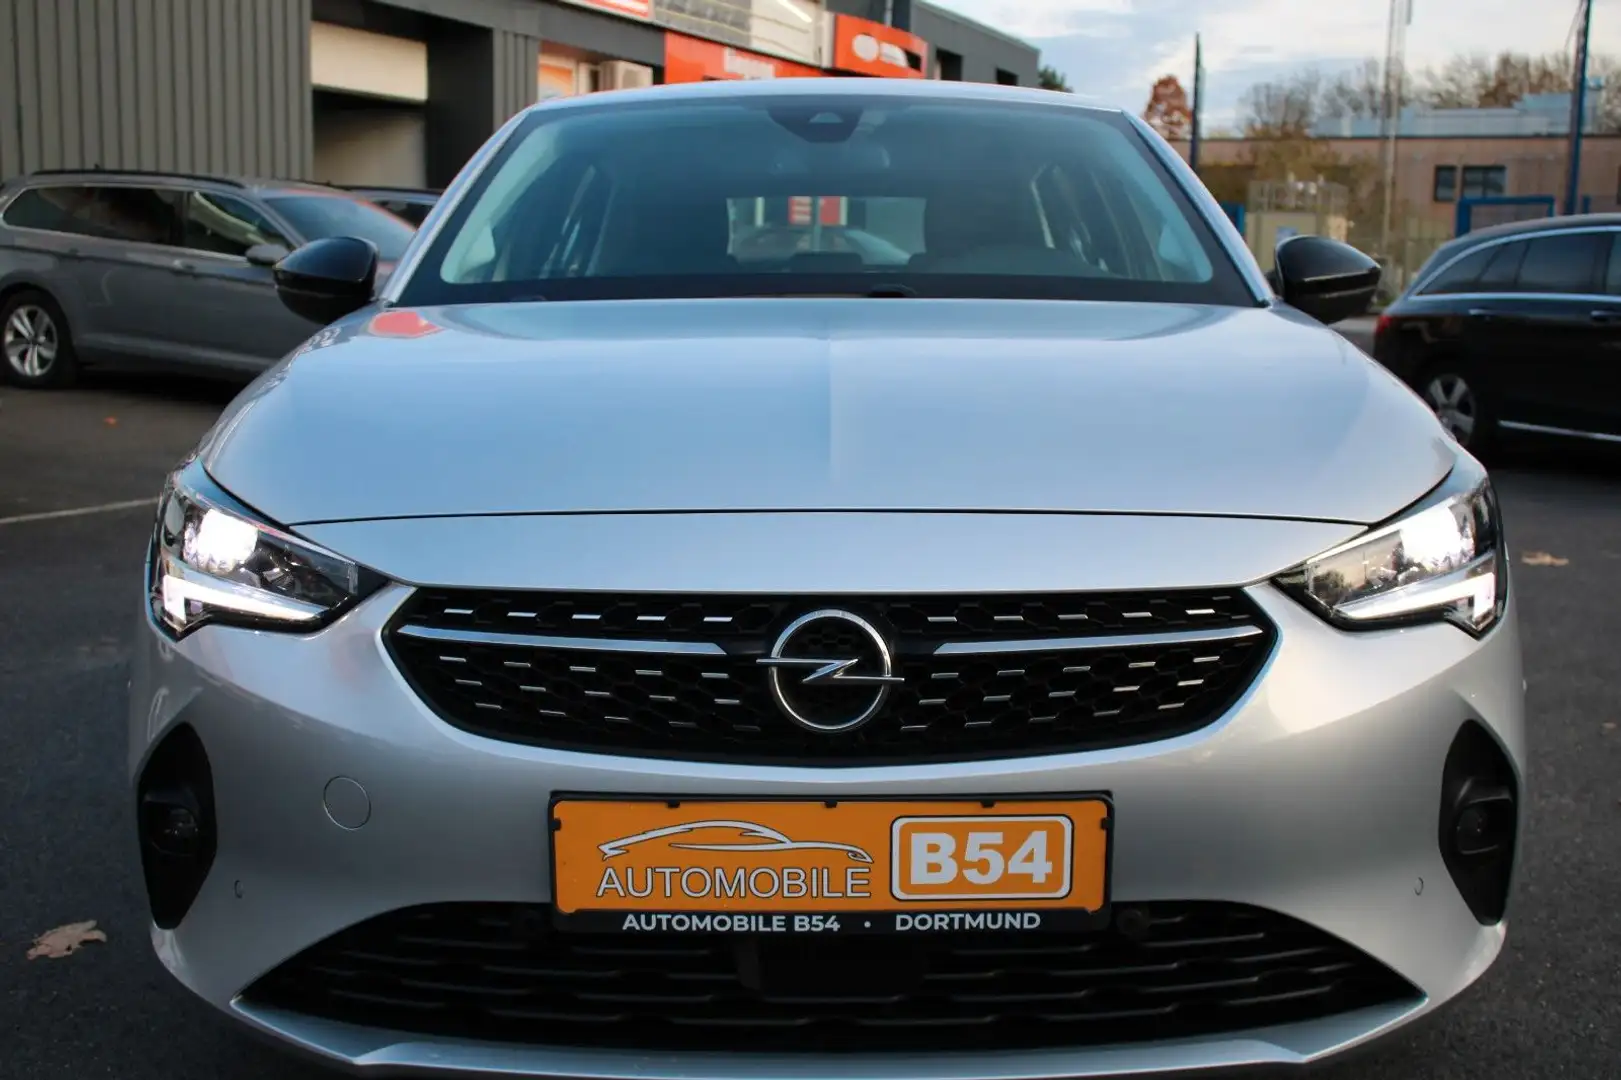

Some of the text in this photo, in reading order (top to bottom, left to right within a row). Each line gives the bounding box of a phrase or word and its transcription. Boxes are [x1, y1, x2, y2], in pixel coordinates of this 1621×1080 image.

[909, 830, 1053, 886] B54
[596, 866, 872, 900] AUTOMOBILE
[622, 912, 1041, 932] AUTOMOBILE B54 DORTMUND
